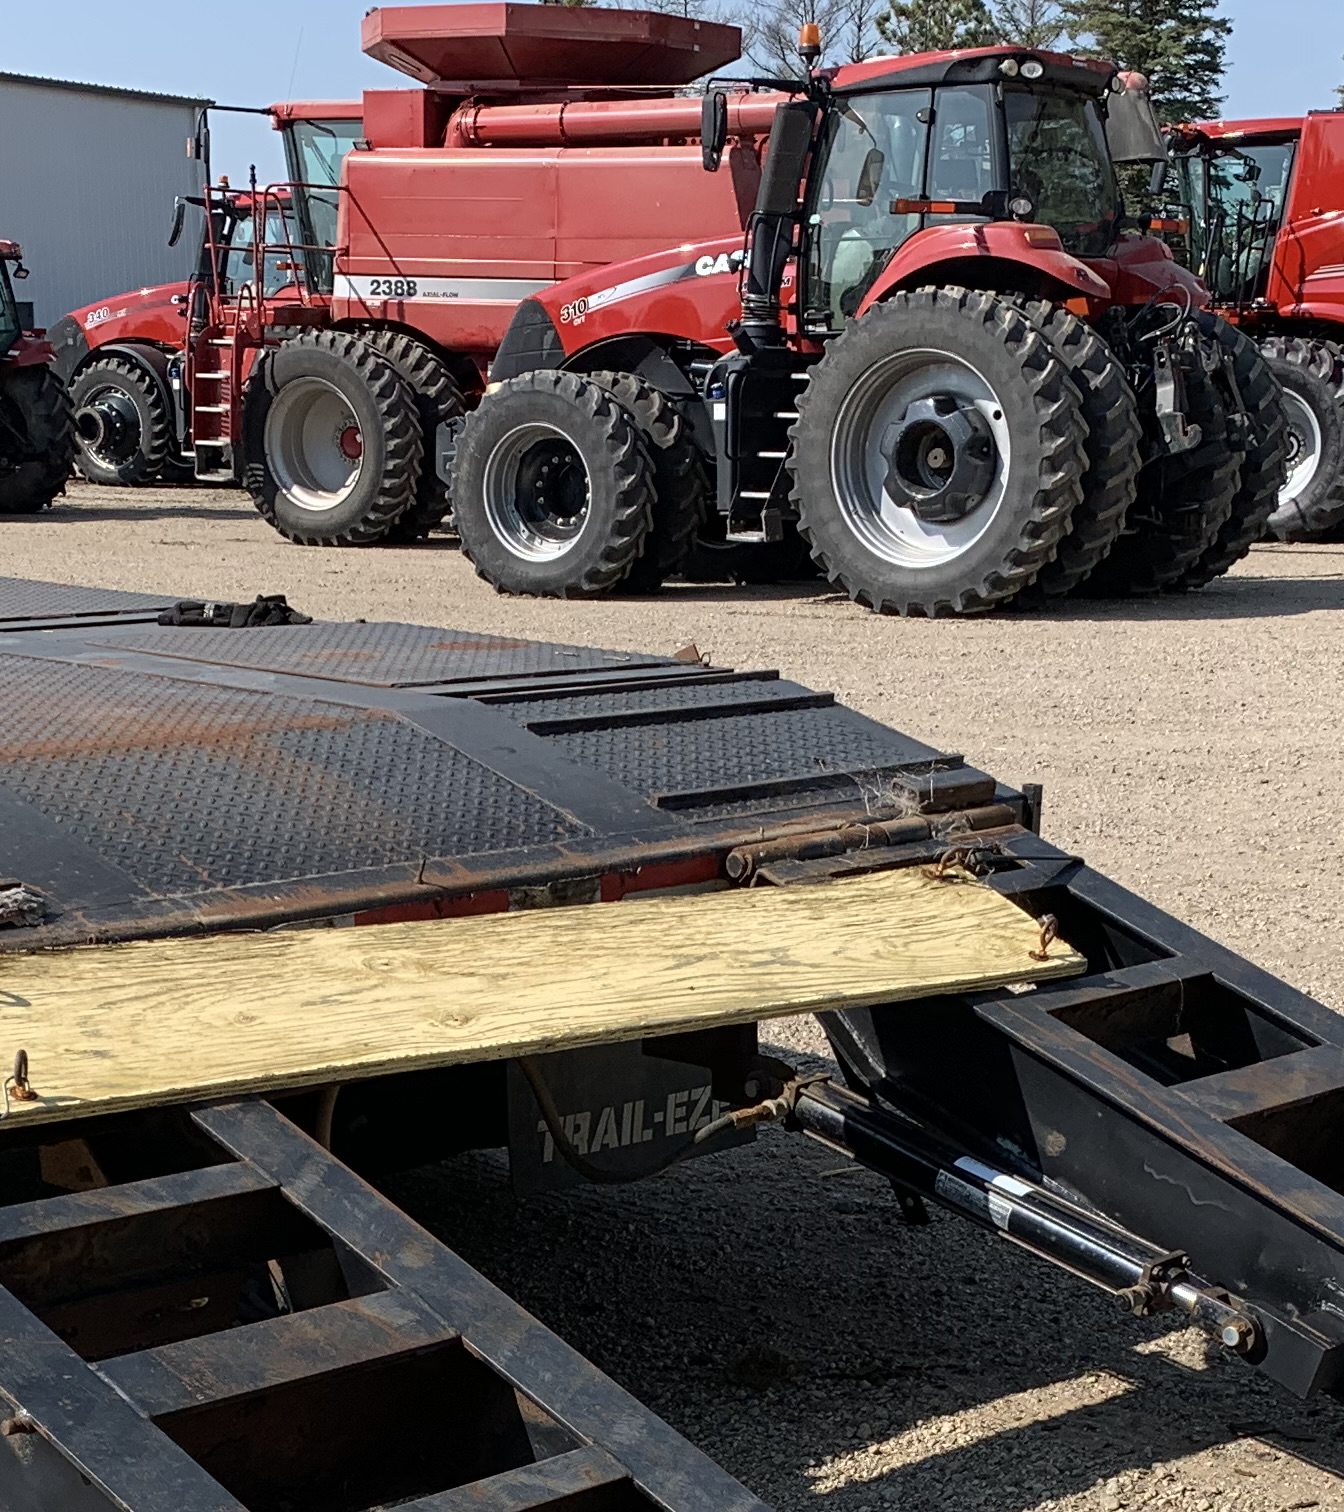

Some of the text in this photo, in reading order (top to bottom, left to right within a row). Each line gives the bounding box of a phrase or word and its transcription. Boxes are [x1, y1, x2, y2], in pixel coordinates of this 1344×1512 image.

[370, 279, 417, 297] 2388
[86, 306, 110, 323] 340
[560, 297, 588, 323] 310
